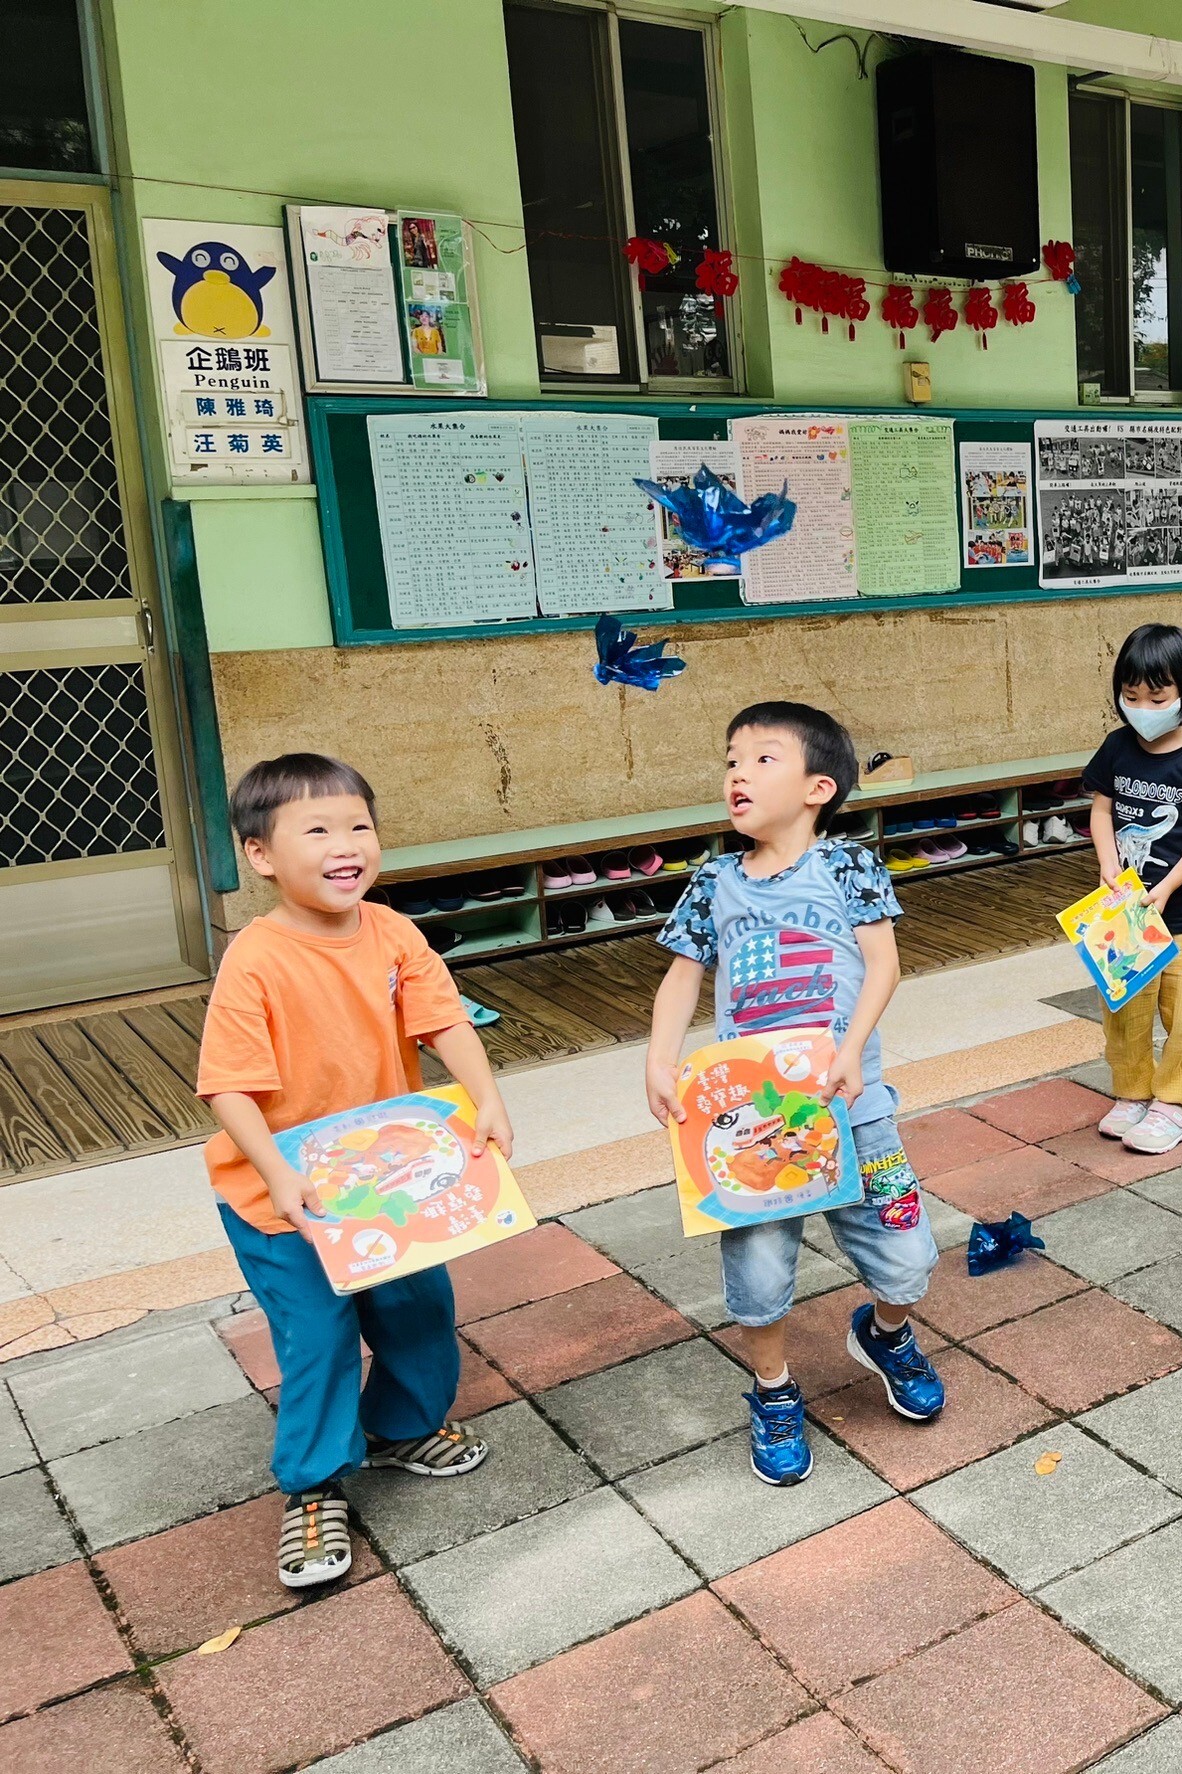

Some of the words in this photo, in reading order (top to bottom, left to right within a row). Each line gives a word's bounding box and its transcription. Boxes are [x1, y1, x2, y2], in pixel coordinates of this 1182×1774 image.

[186, 346, 271, 372] 企鵝班
[194, 374, 270, 390] Penguin
[195, 397, 274, 417] 陳雅琦
[193, 433, 284, 454] 汪菊英
[697, 1062, 731, 1092] 臺灣
